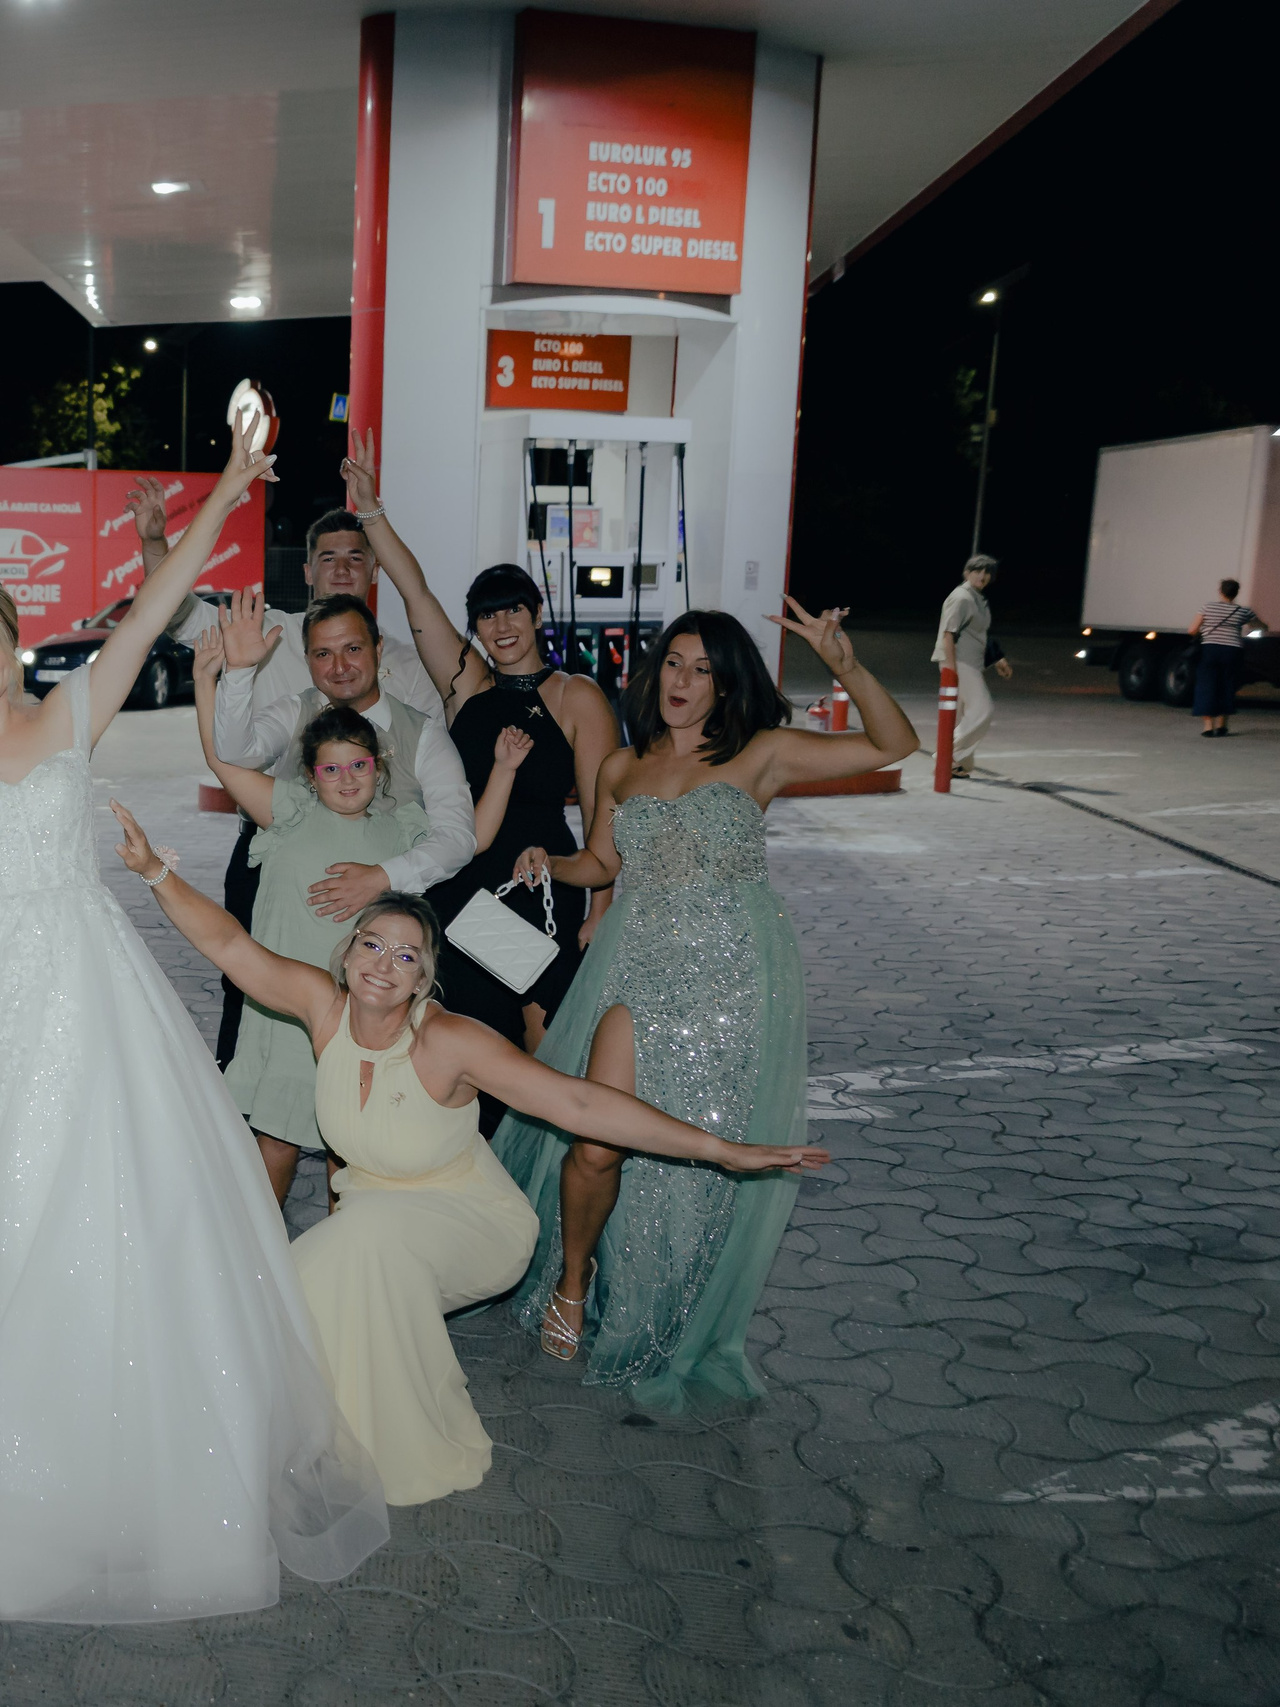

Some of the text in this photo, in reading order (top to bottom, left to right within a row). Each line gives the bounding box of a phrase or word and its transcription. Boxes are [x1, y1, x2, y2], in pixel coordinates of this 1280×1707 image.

[588, 141, 692, 169] EUROLUK 95
[587, 171, 668, 197] ECTO 100
[538, 198, 556, 249] 1
[586, 201, 701, 229] EURO L DIESEL
[584, 230, 738, 262] ECTO SUPER DIESEL
[534, 338, 583, 356] ECTO 100
[496, 355, 515, 388] 3
[532, 358, 561, 372] EURO
[571, 360, 603, 374] DIESEL
[531, 375, 624, 392] ECTO SUPER DIESEL
[4, 584, 61, 603] TORIE
